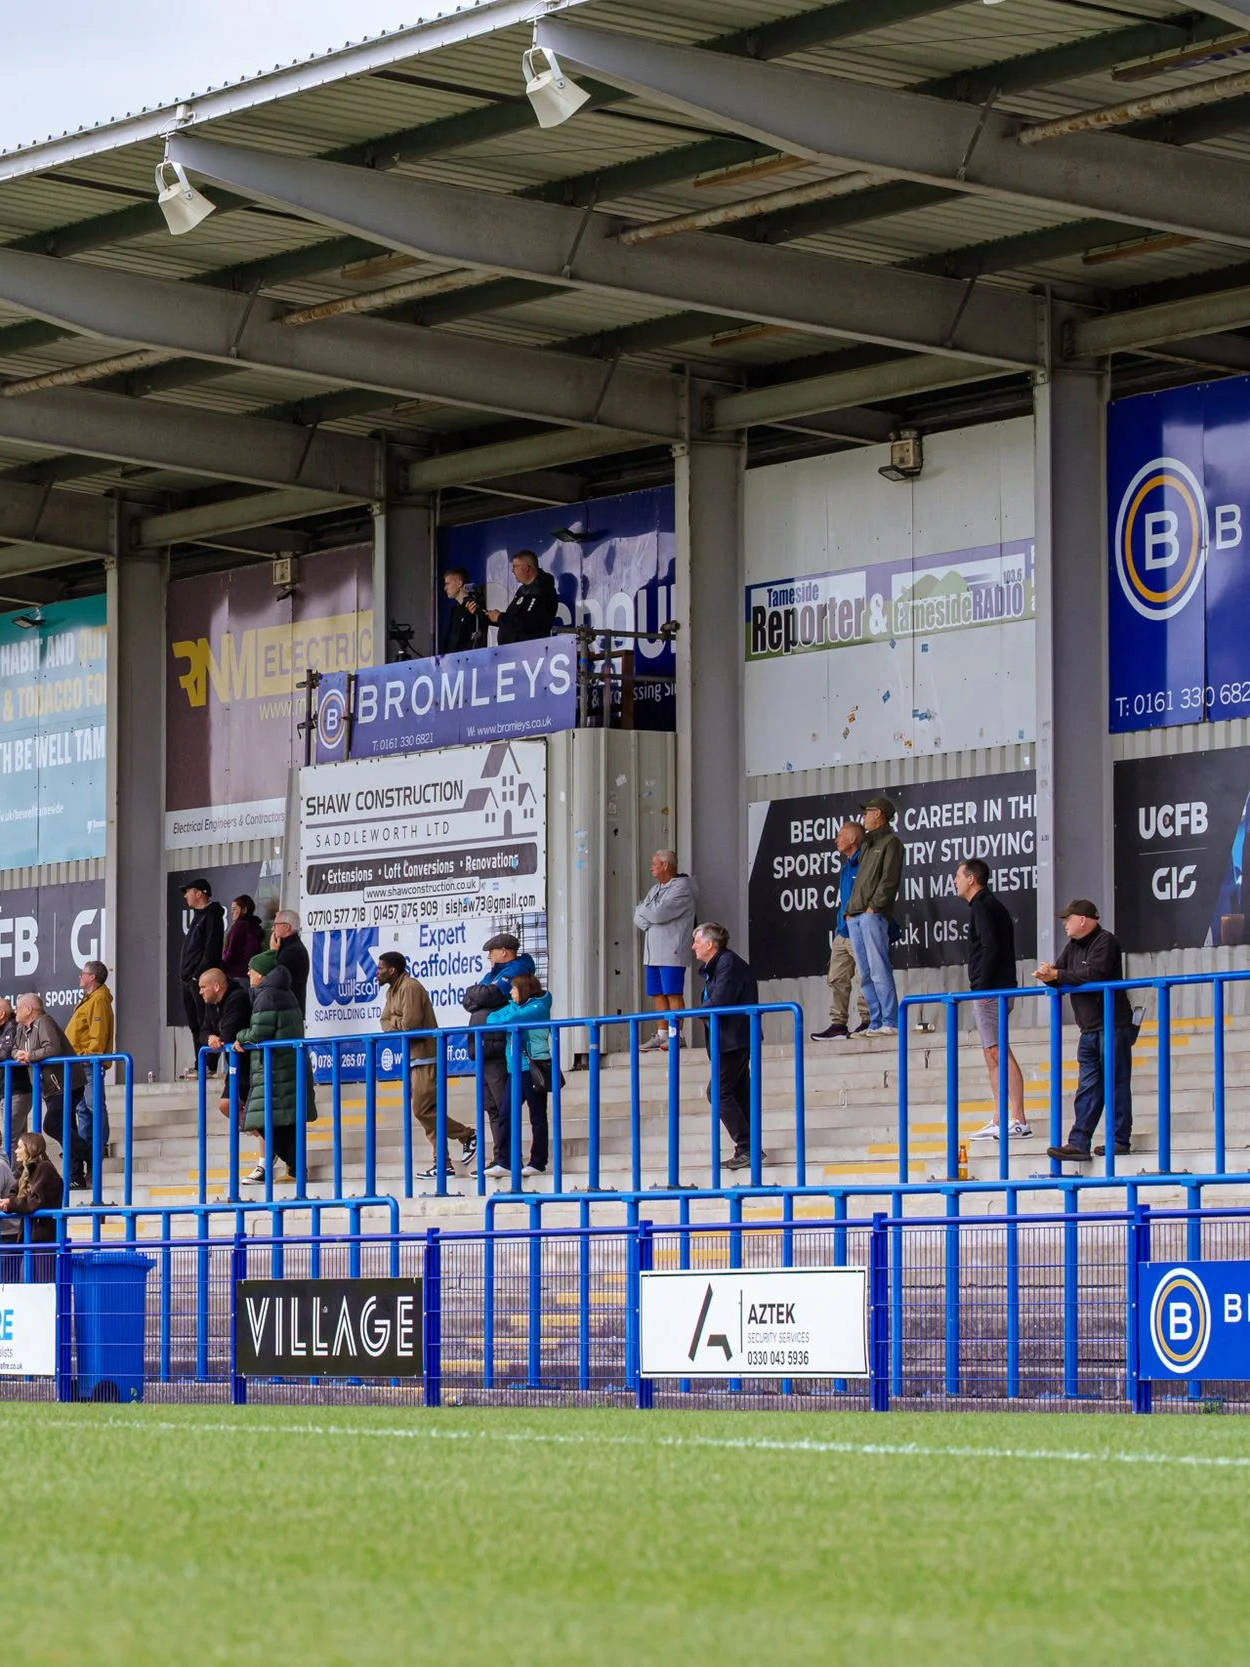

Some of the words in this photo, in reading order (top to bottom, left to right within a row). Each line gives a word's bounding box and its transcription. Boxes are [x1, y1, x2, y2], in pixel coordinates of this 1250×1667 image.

[1145, 510, 1180, 570] B
[767, 582, 819, 608] Tameside
[752, 596, 866, 654] Reporter
[869, 593, 888, 635] &
[1, 638, 43, 677] HABIT
[46, 632, 74, 669] AND
[264, 628, 372, 678] ELECTRIC
[2, 689, 14, 722] &
[17, 677, 82, 720] TOBACCO
[358, 654, 571, 724] BROMLEYS
[1134, 690, 1174, 716] 0161
[1180, 686, 1214, 709] 330
[326, 708, 338, 730] B
[478, 716, 552, 737] www.bromleys.co.uk
[14, 738, 32, 772] BE
[36, 732, 72, 768] WELL
[380, 738, 398, 750] 0161
[400, 735, 412, 748] 330
[414, 732, 434, 746] 6821
[306, 793, 351, 816] SHAW
[356, 780, 463, 811] CONSTRUCTION
[173, 818, 204, 834] Electrical
[204, 816, 236, 833] Engineers
[238, 816, 244, 827] &
[245, 812, 285, 826] Contractors
[316, 824, 418, 848] SADDLEWORTH
[426, 821, 450, 836] LTD
[790, 816, 844, 844] BEGIN
[904, 801, 978, 831] CAREER
[984, 798, 1002, 822] IN
[1008, 794, 1036, 820] TH
[1138, 802, 1208, 840] UCFB
[940, 830, 1034, 862] STUDYING
[328, 868, 372, 885] Extensions
[384, 863, 400, 880] Loft
[404, 860, 454, 878] Conversions
[466, 852, 519, 871] Renovations
[773, 851, 841, 879] SPORTS
[367, 880, 476, 898] www.shawconstruction.co.uk
[780, 887, 818, 912] OUR
[905, 877, 924, 900] IN
[1152, 865, 1196, 900] GIS
[308, 910, 331, 926] 07710
[334, 908, 350, 924] 577
[352, 906, 366, 922] 718
[374, 904, 398, 921] 01457
[420, 900, 438, 916] 909
[446, 894, 536, 914] sishaw73@gmail.com
[419, 922, 466, 952] Expert
[404, 952, 482, 978] Scaffolders
[46, 989, 84, 1008] SPORTS
[314, 1006, 366, 1022] SCAFFOLDING
[368, 1006, 382, 1019] LTD
[342, 1054, 356, 1067] 265
[246, 1296, 413, 1357] VILLAGE
[748, 1303, 796, 1324] AZTEK
[1170, 1302, 1192, 1340] B
[748, 1332, 776, 1344] SECURITY
[778, 1332, 810, 1344] SERVICES
[748, 1351, 768, 1366] 0330
[770, 1351, 786, 1366] 043
[788, 1350, 809, 1366] 5936
